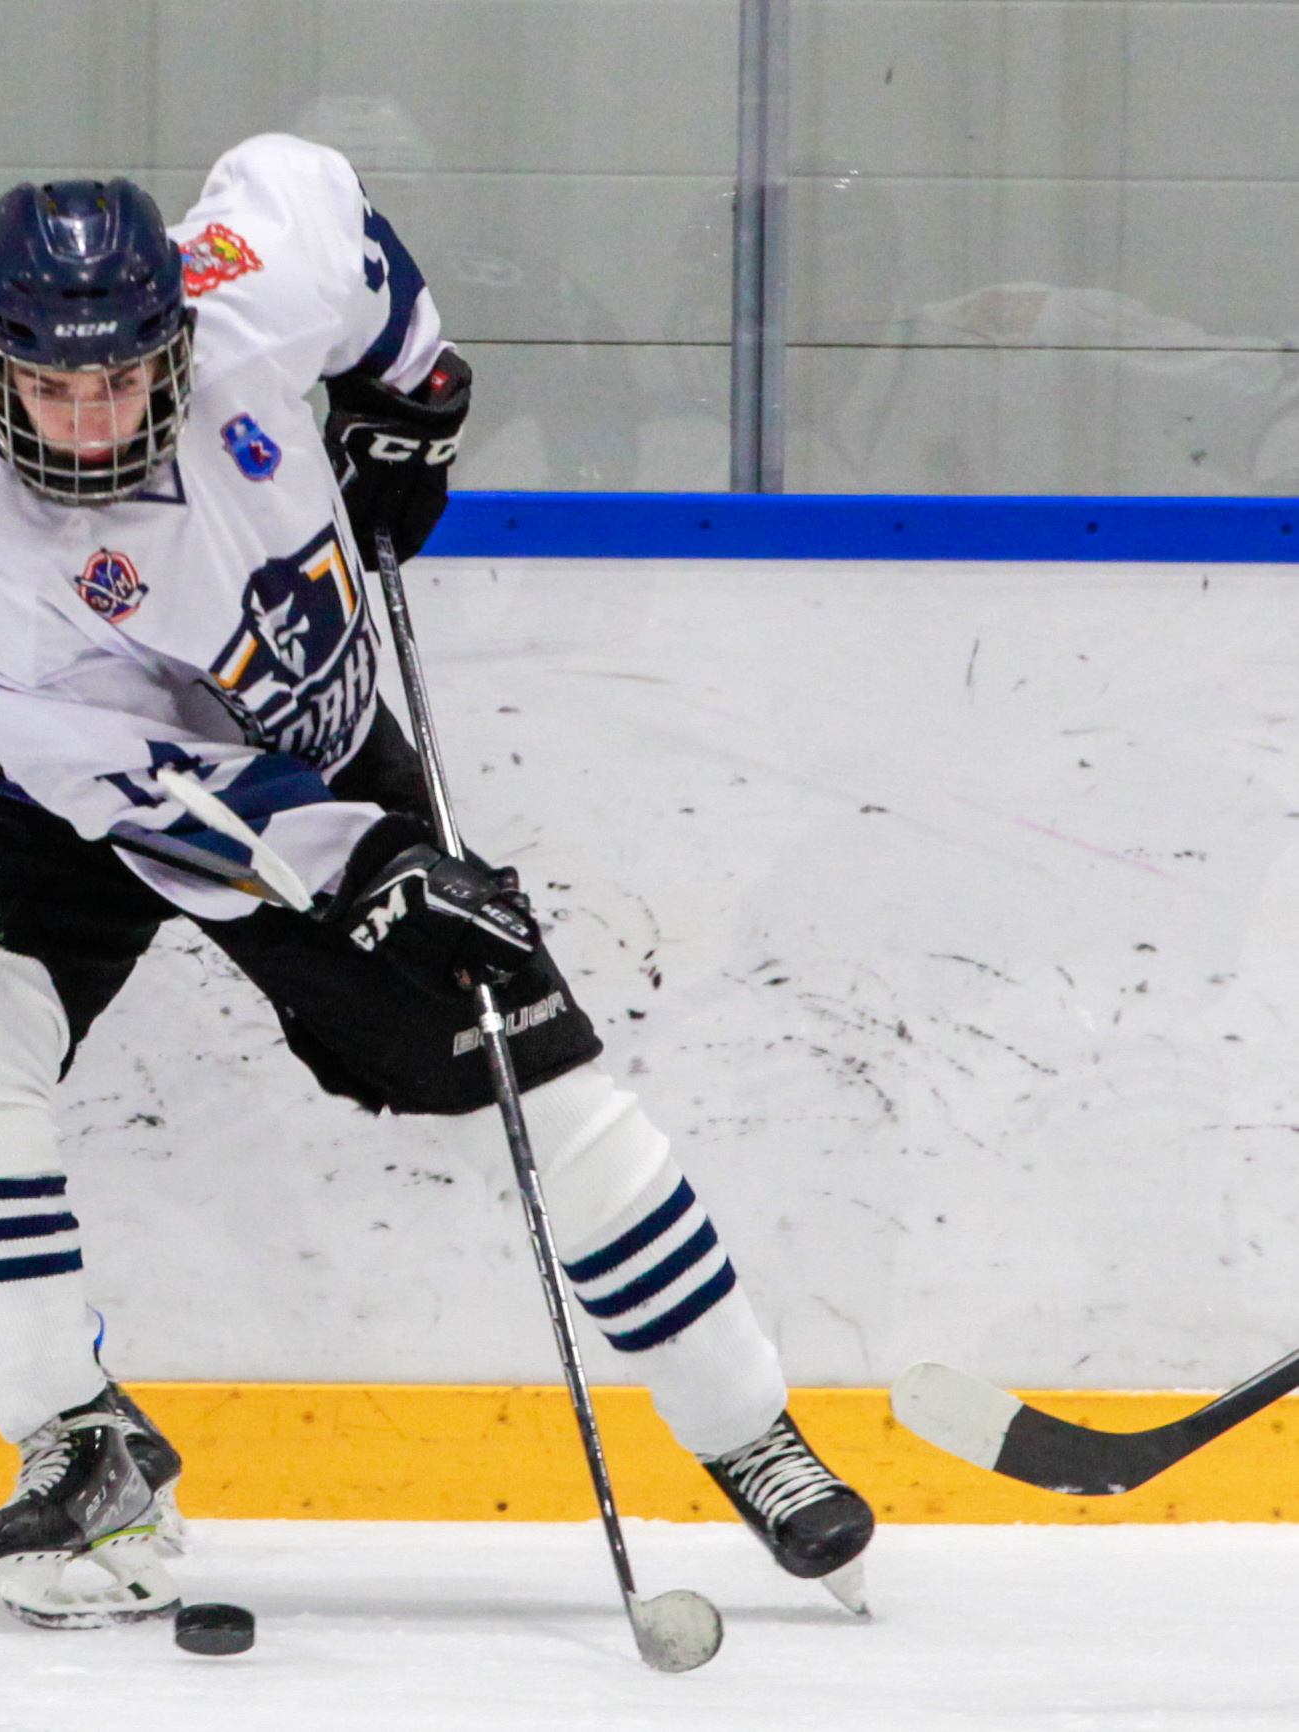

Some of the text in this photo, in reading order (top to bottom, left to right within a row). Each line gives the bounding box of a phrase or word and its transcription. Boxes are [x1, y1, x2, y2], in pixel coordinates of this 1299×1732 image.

[368, 426, 463, 466] CC
[349, 883, 408, 951] CM
[452, 990, 567, 1057] BUER
